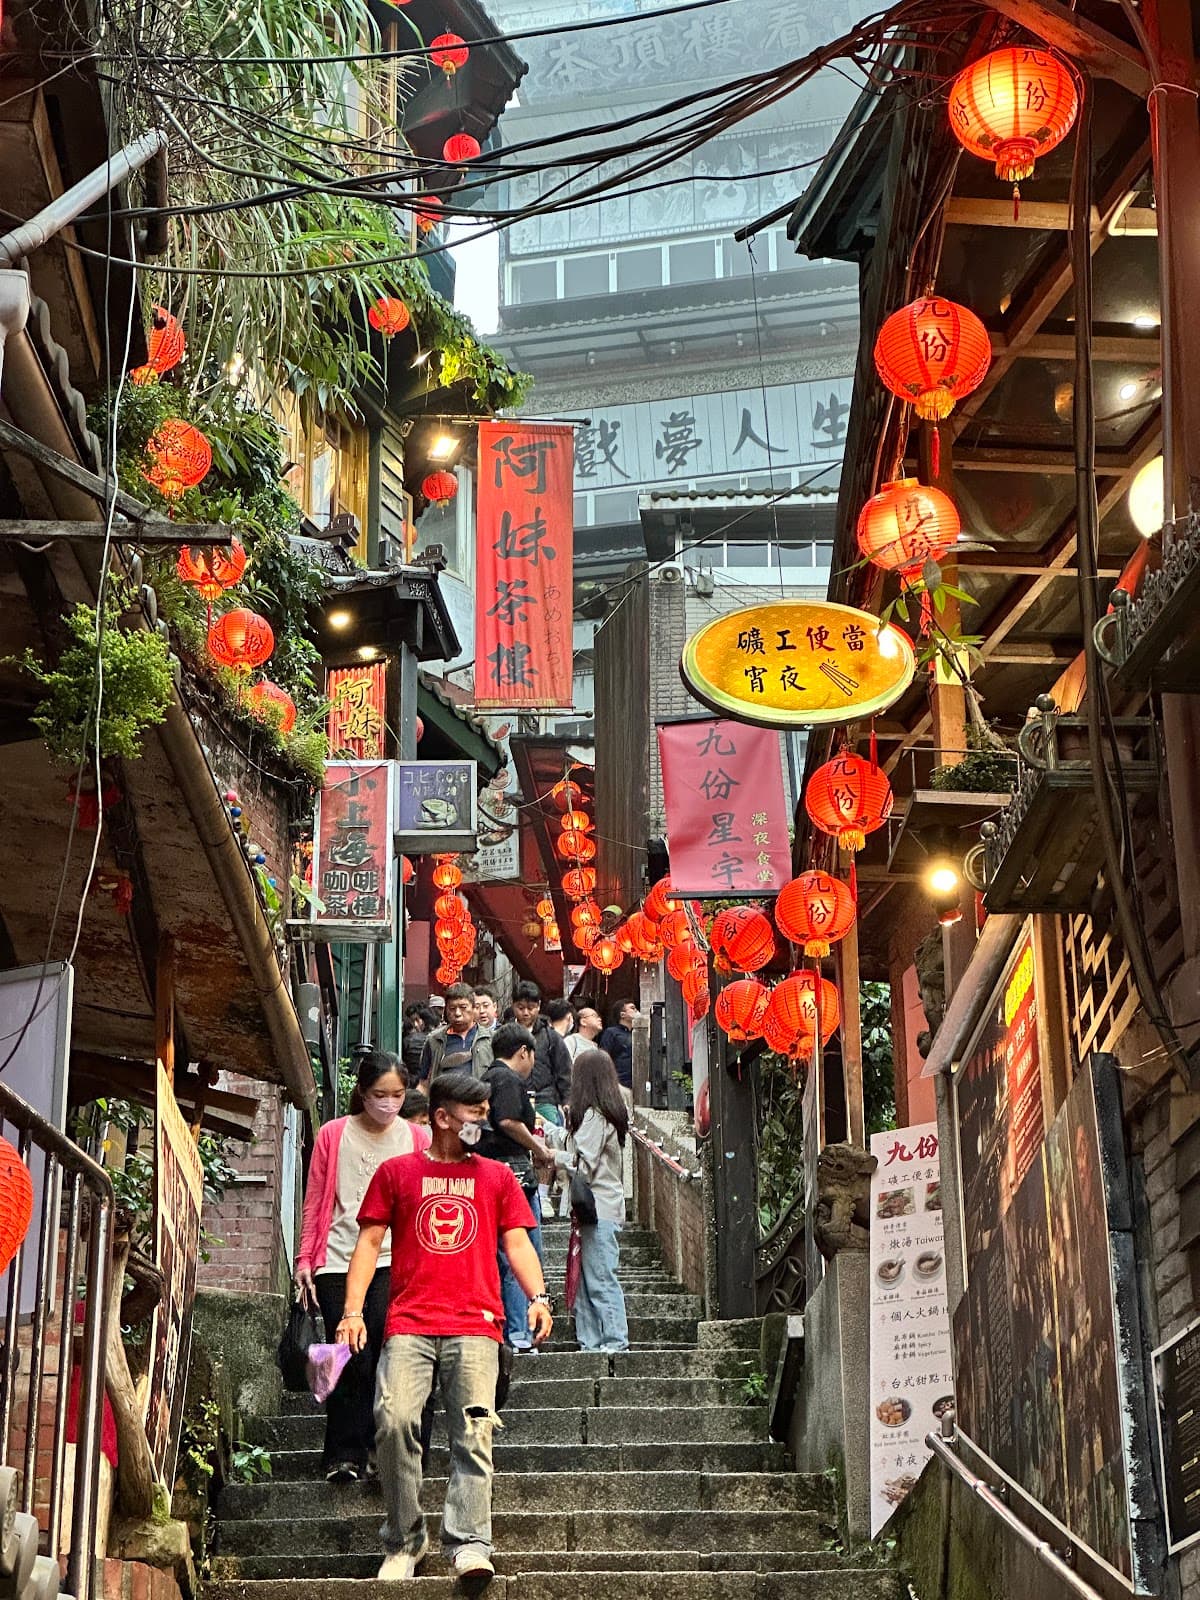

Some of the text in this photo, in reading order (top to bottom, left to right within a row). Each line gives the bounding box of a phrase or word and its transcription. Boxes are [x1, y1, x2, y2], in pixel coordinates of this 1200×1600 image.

[1023, 50, 1050, 112] 九份
[919, 302, 954, 362] 九份
[573, 392, 850, 479] 戲夢人生
[486, 436, 557, 688] 阿妹茶樓
[737, 623, 867, 655] 礦工便當
[744, 665, 806, 693] 宵夜
[335, 678, 381, 740] 阿妹
[696, 727, 743, 885] 九份星宇
[832, 760, 858, 810] 九份
[751, 811, 774, 883] 深夜食堂
[323, 870, 379, 893] 咖啡
[325, 894, 380, 917] 茶樓
[808, 877, 831, 924] 九份
[884, 1134, 939, 1166] 九份
[891, 1305, 939, 1321] 個人火鍋
[891, 1373, 940, 1389] 台式甜點
